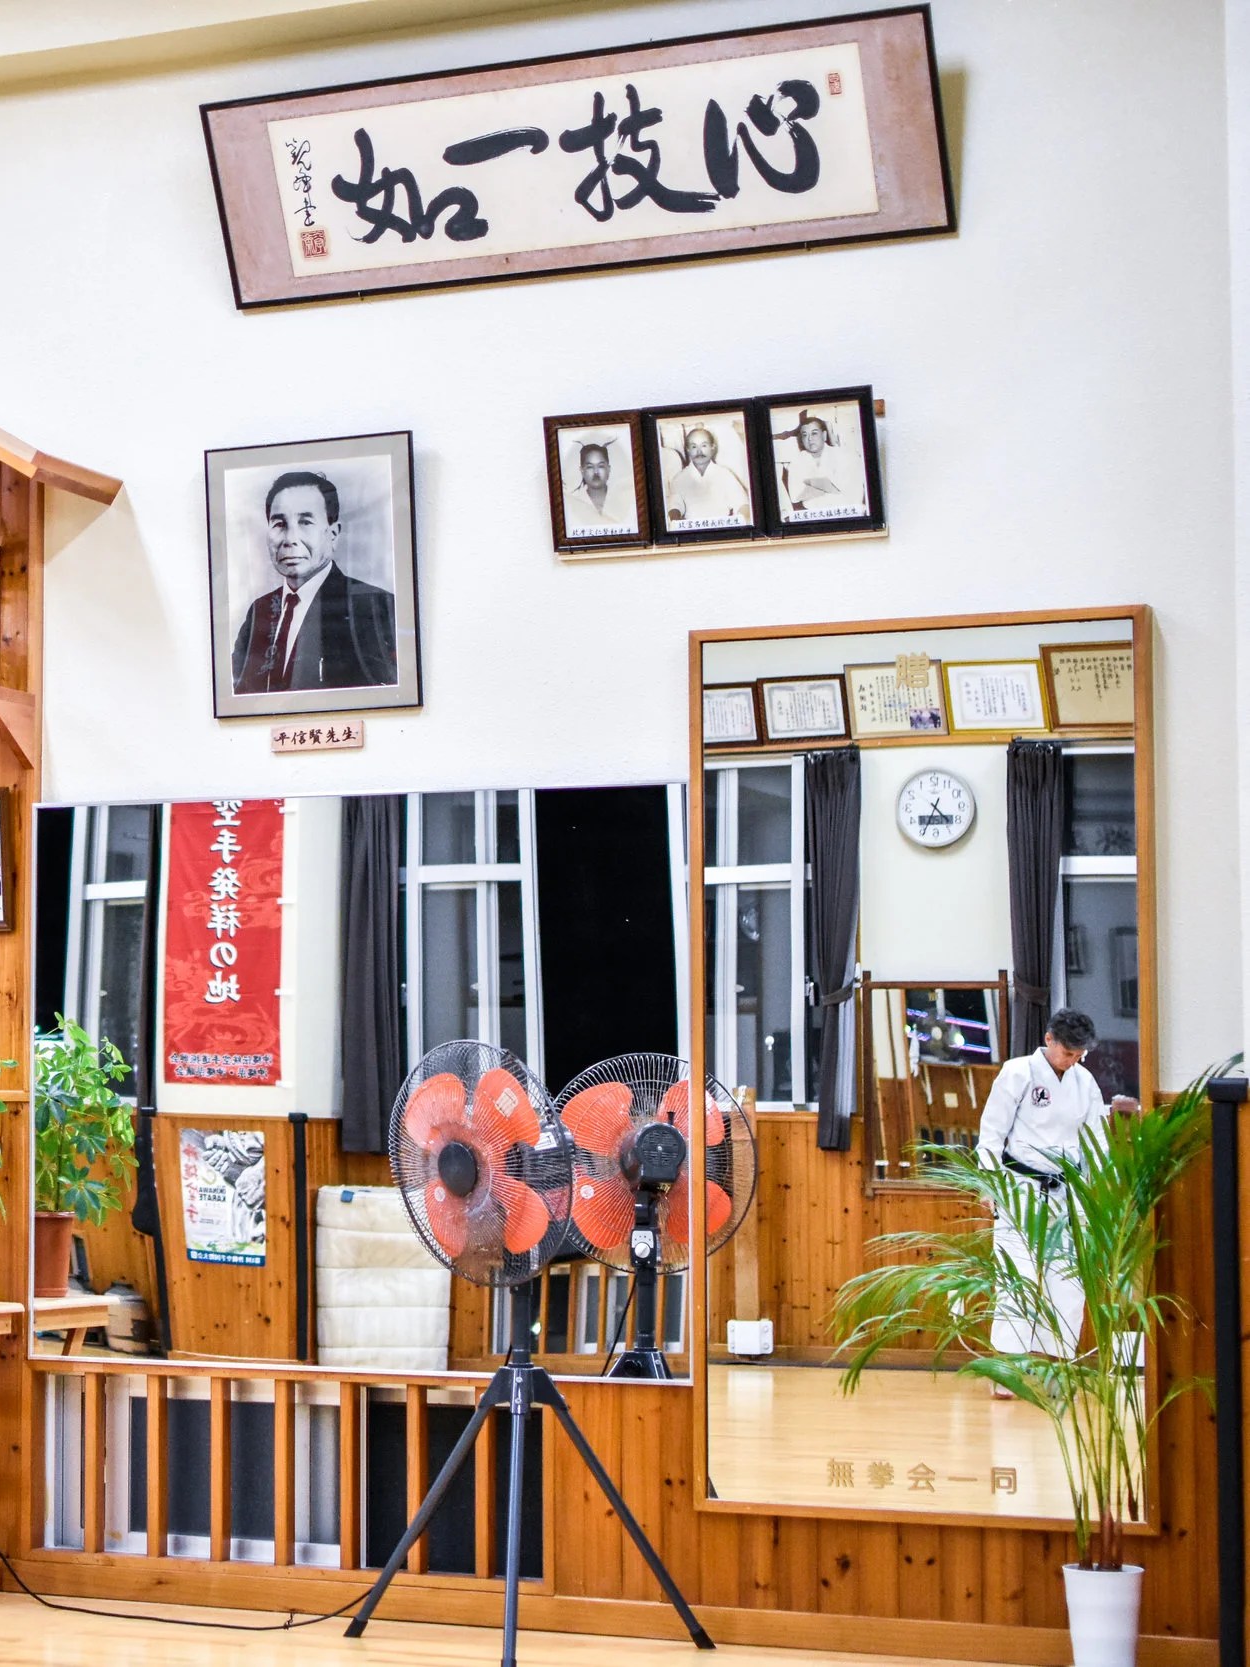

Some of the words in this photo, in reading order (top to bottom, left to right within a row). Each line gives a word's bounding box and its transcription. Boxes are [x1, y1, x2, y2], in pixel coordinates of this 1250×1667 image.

[331, 79, 822, 245] 心技一如
[274, 726, 357, 746] 平信賢先生
[827, 1457, 1018, 1495] 無拳会一同
